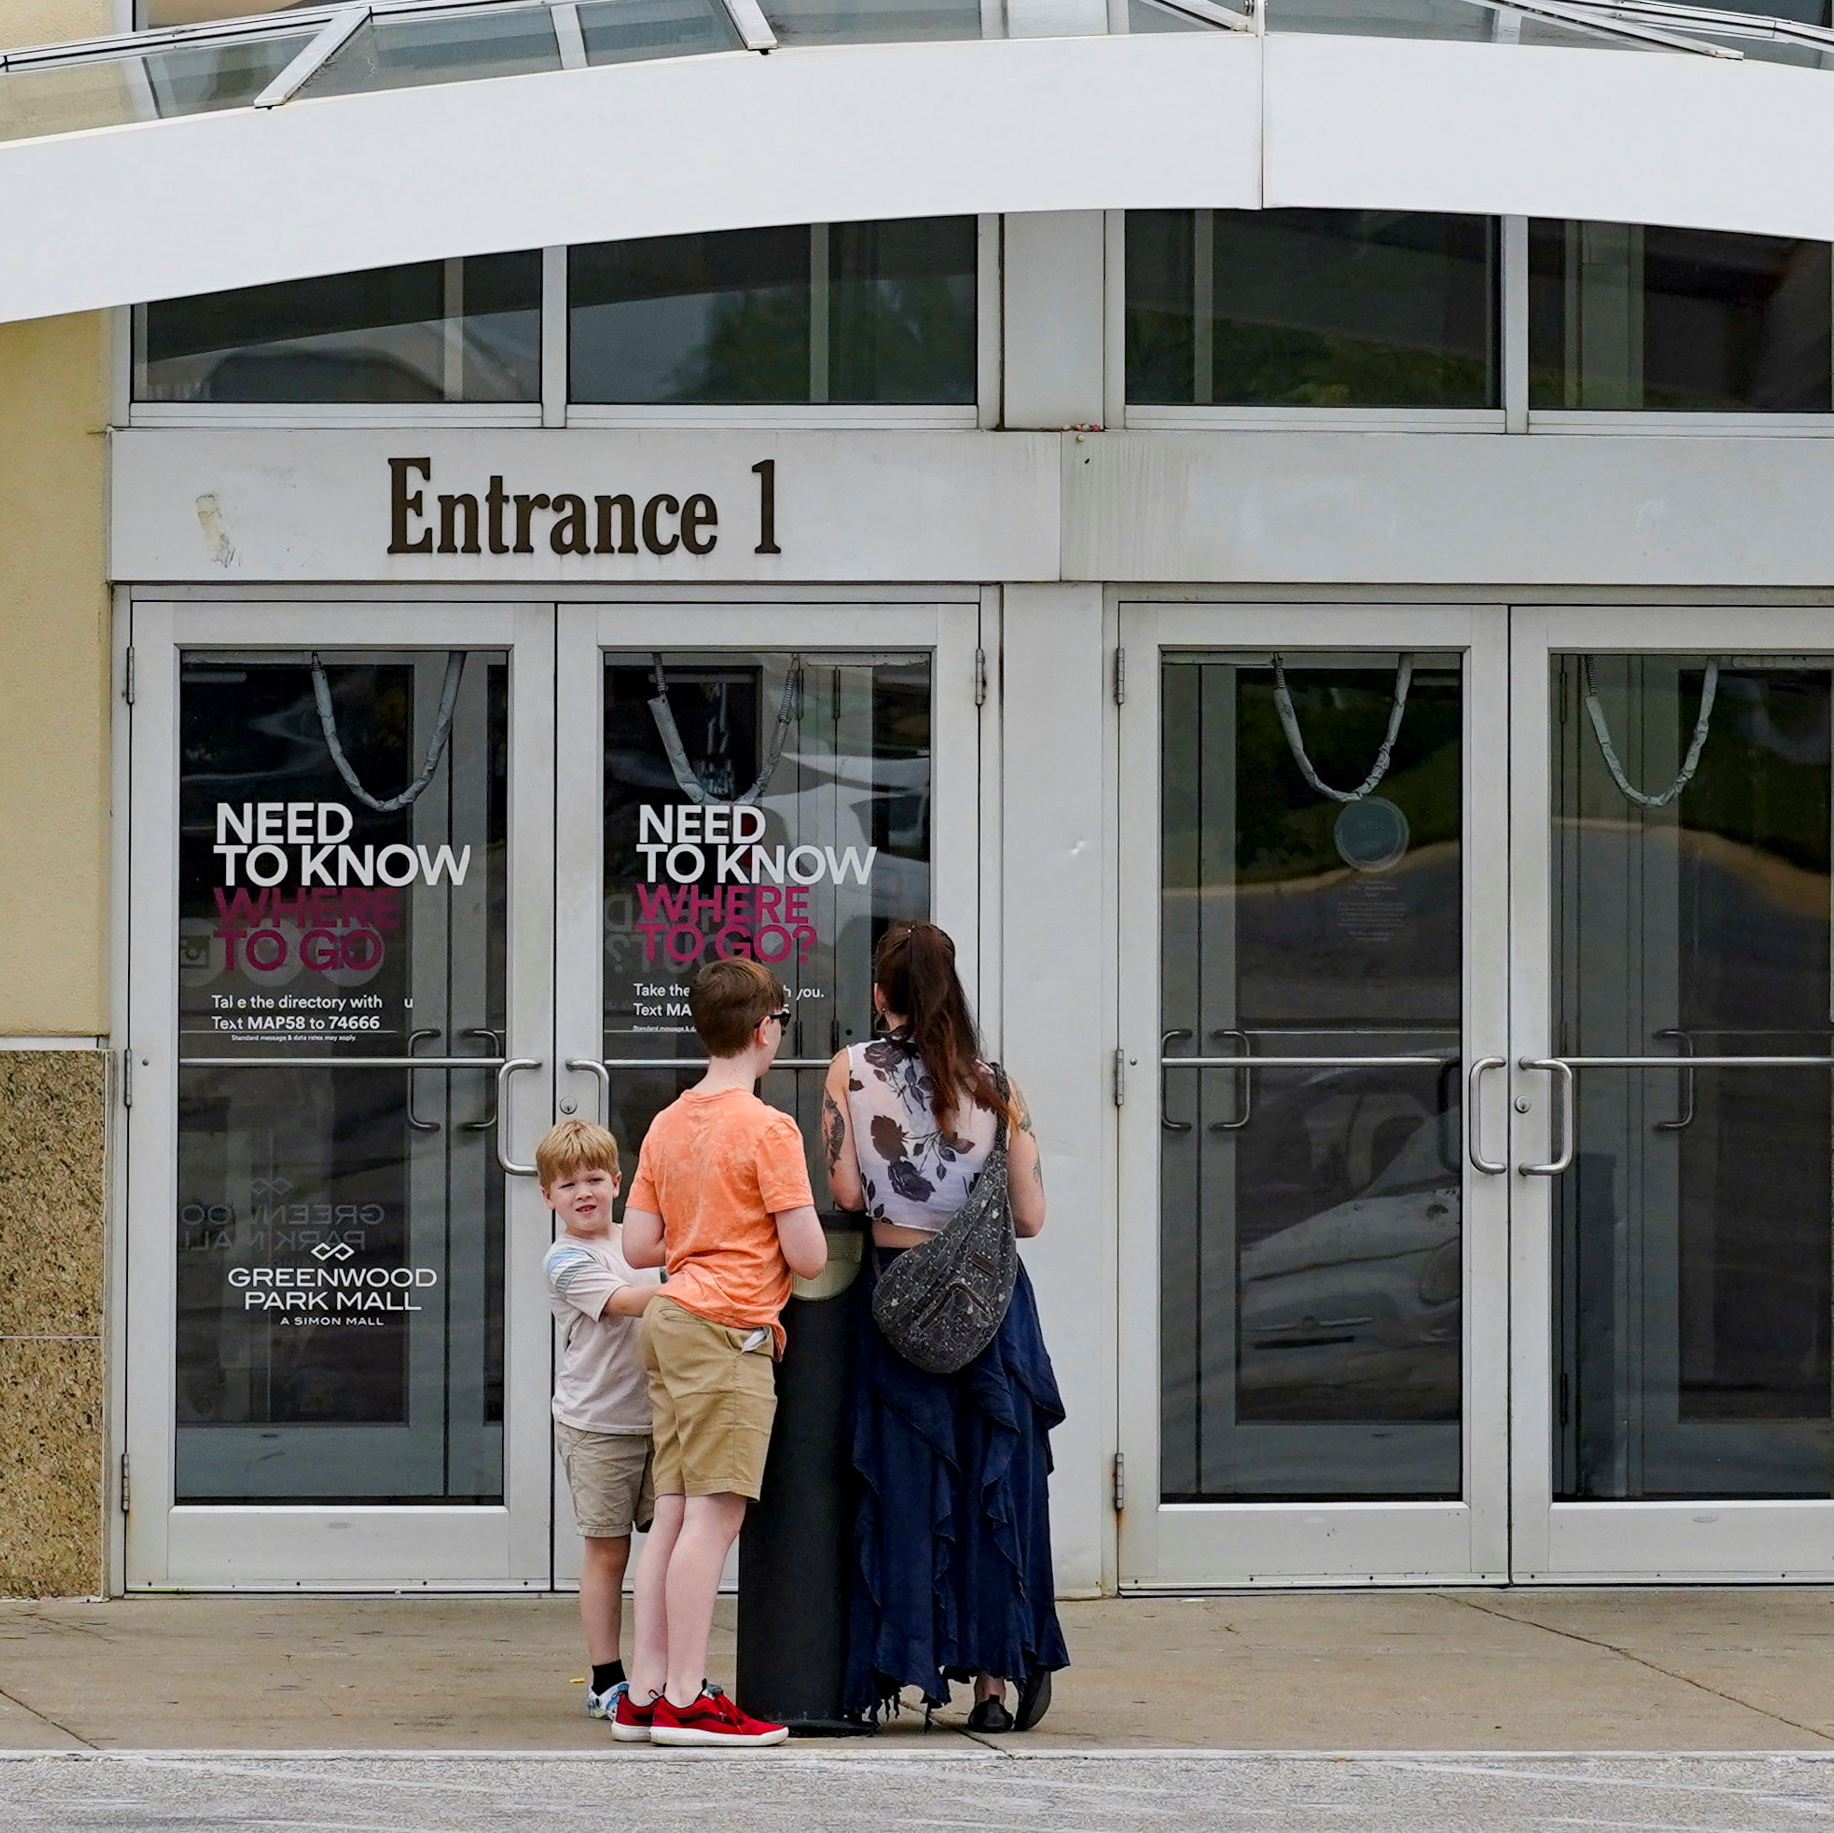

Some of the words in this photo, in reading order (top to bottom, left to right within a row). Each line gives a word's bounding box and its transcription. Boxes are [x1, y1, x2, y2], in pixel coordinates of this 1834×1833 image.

[386, 456, 719, 556] Entrance
[751, 458, 781, 556] 1
[216, 802, 355, 844] NEED
[639, 804, 767, 844] NEED
[213, 844, 289, 887] TO
[301, 844, 471, 887] KNOW
[636, 843, 706, 884] TO
[717, 844, 877, 885] KNOW
[213, 887, 401, 928] WHERE
[636, 883, 810, 924] WHERE
[213, 929, 288, 971] TO
[299, 929, 383, 971] GO
[636, 922, 705, 962] TO
[715, 923, 818, 963] GO?
[250, 995, 275, 1009] the
[278, 995, 346, 1012] directory
[350, 995, 382, 1009] with
[633, 983, 666, 997] Take
[669, 984, 690, 997] the
[633, 1003, 663, 1017] Text
[211, 1016, 244, 1030] Text
[248, 1016, 305, 1030] MAP58
[310, 1017, 325, 1030] to
[329, 1016, 380, 1030] 74666
[227, 1267, 437, 1288] GREENWOOD
[244, 1292, 329, 1311] PARK
[336, 1292, 422, 1311] MALL
[280, 1317, 290, 1326] A
[294, 1317, 342, 1326] SIMON
[346, 1317, 384, 1326] MALL
